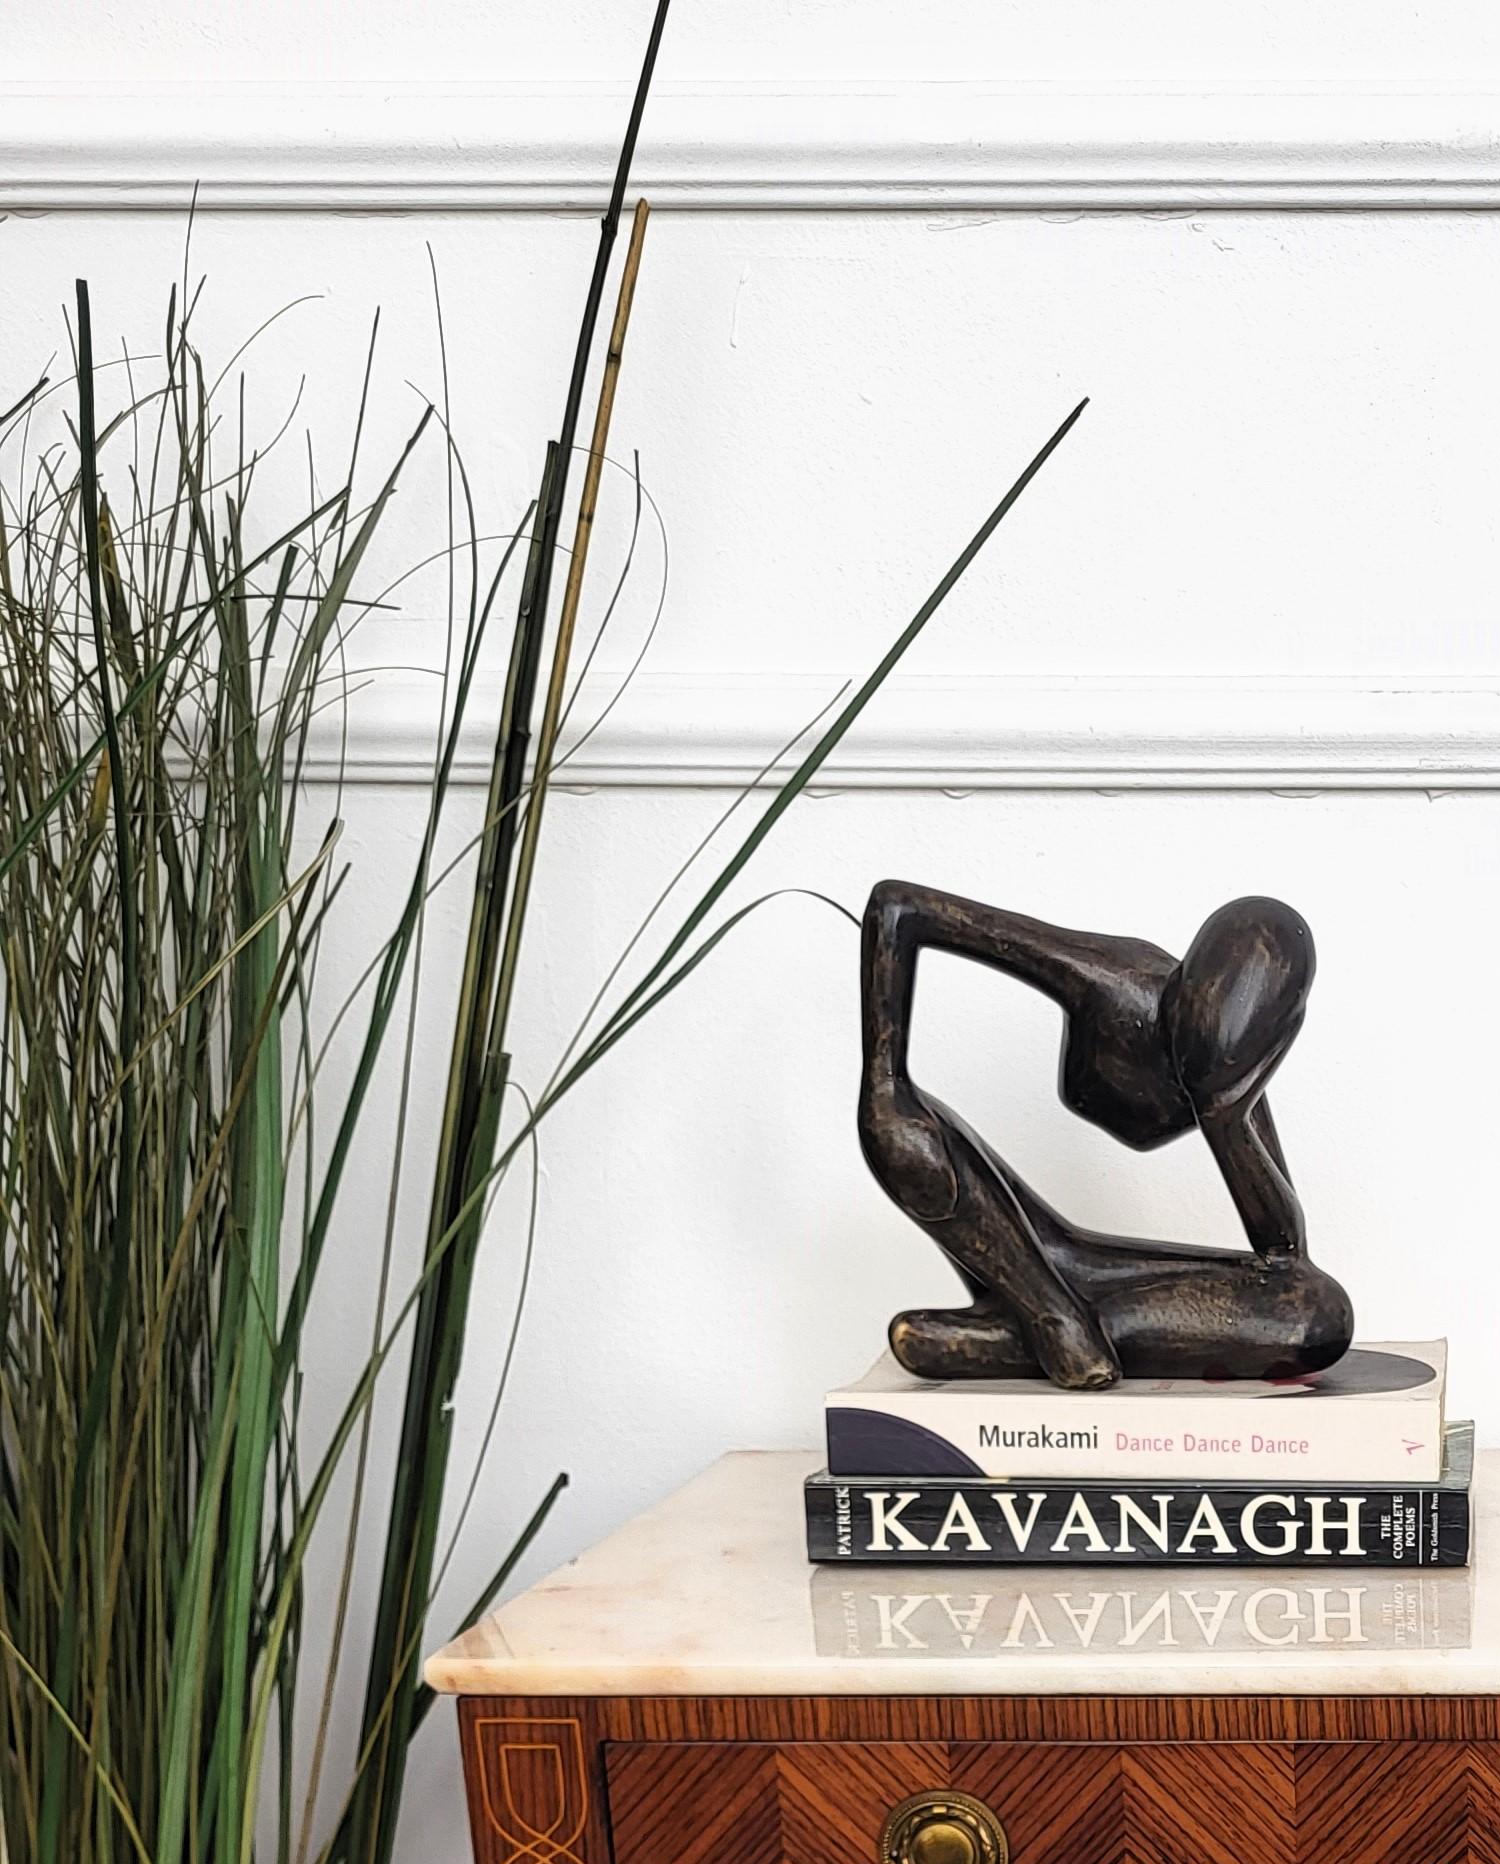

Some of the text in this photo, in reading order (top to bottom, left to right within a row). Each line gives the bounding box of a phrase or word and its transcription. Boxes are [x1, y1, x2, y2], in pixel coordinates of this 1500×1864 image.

[979, 1424, 1098, 1449] Murakami
[1116, 1433, 1309, 1454] Dance Dance Dance
[835, 1486, 852, 1555] PATRICK
[862, 1491, 1368, 1556] KAVANAGH
[1380, 1515, 1391, 1540] THE
[1392, 1495, 1404, 1559] COMPLETE
[1405, 1507, 1416, 1547] POEMS
[1430, 1548, 1439, 1562] The
